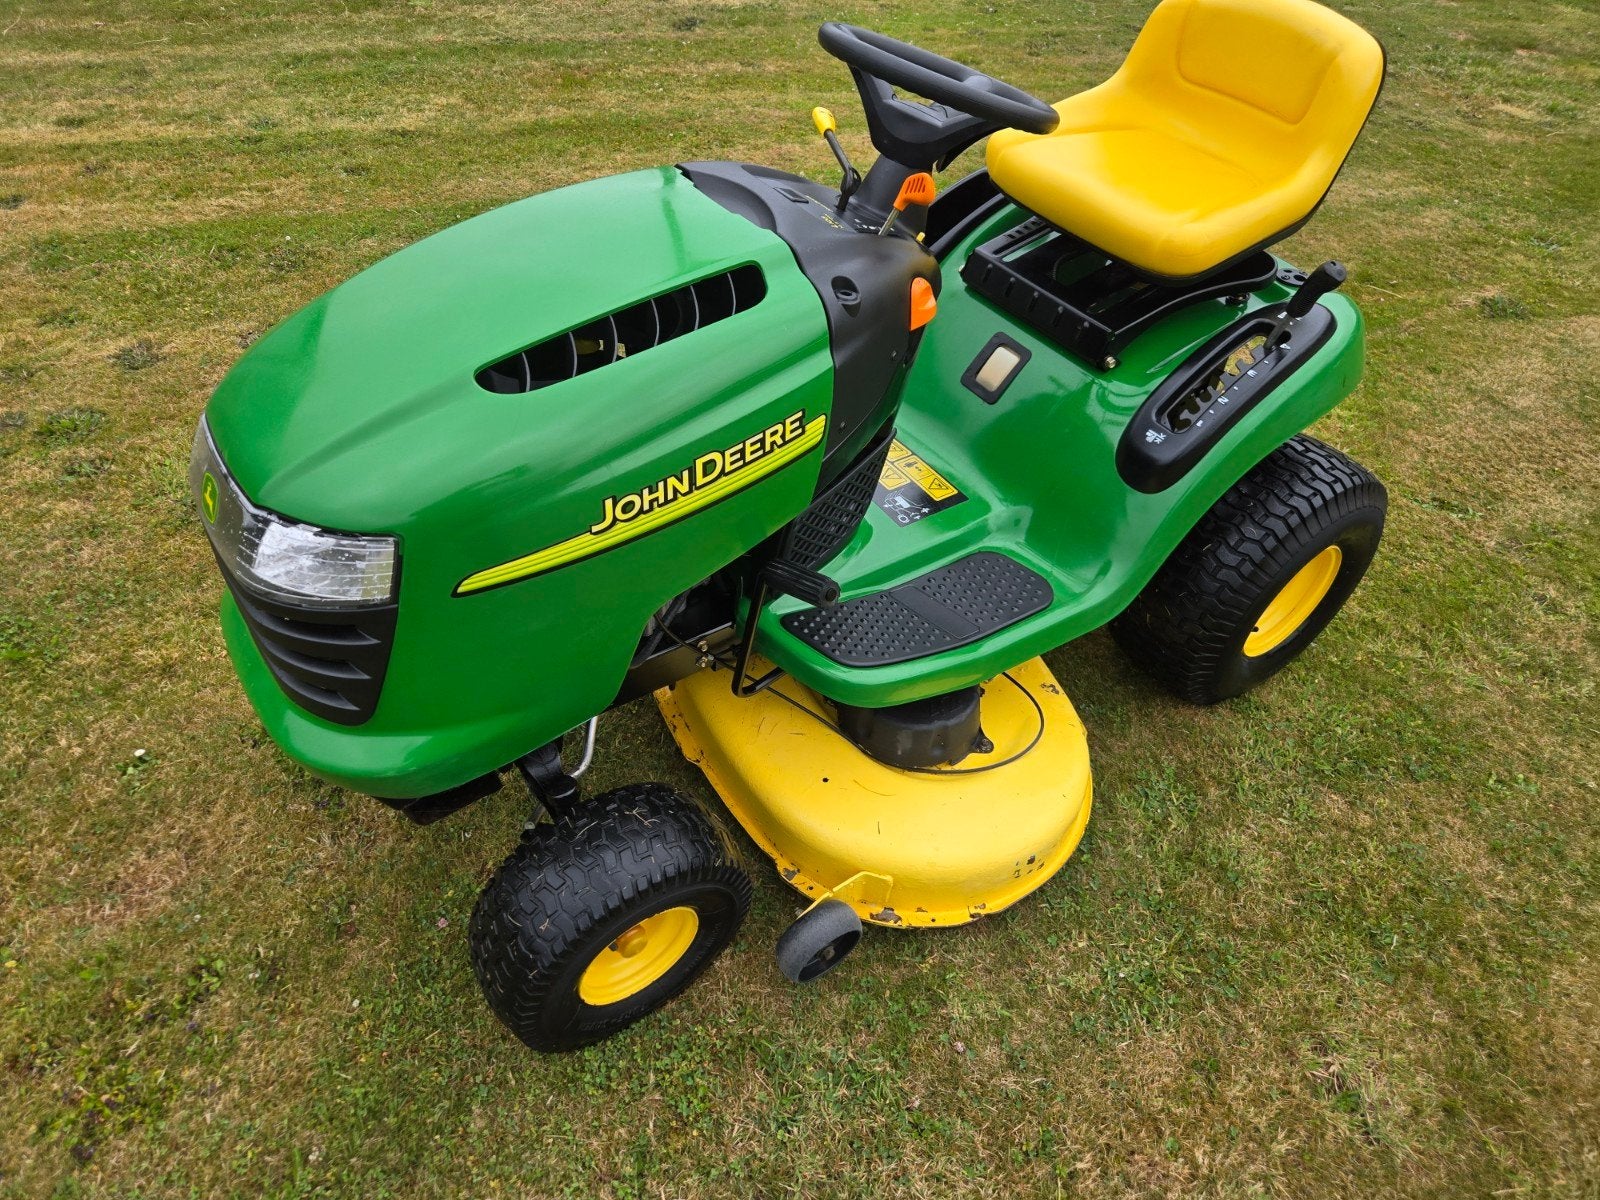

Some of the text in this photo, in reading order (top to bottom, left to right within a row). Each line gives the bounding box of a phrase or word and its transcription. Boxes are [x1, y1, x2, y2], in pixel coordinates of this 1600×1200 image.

[1246, 369, 1257, 378] 3
[1217, 395, 1229, 405] 2
[590, 409, 805, 535] JOHN DEERE
